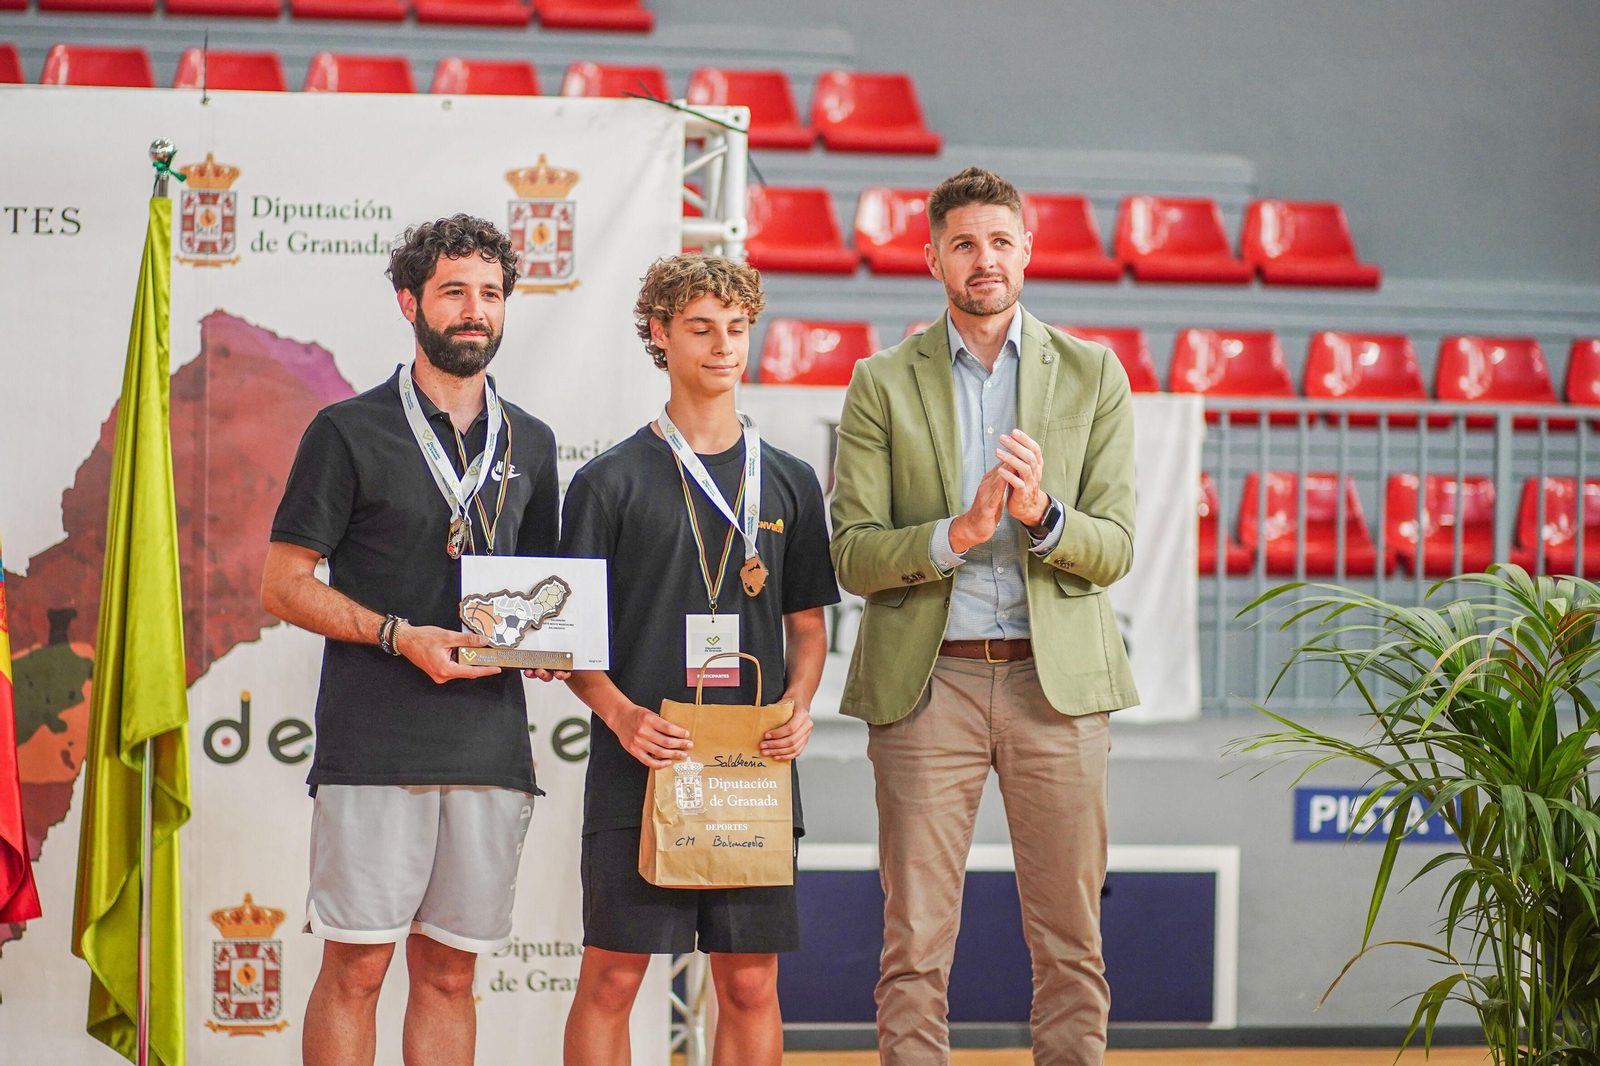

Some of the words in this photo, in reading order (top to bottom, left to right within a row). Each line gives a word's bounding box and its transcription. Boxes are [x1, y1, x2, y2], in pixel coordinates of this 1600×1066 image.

[252, 194, 392, 224] Diputación
[250, 230, 278, 254] de
[287, 230, 391, 255] Granada
[495, 461, 515, 475] NE
[708, 777, 778, 791] Diputación
[709, 794, 724, 807] de
[727, 794, 778, 807] Granada
[705, 823, 748, 831] DEPORTES
[490, 969, 518, 993] de
